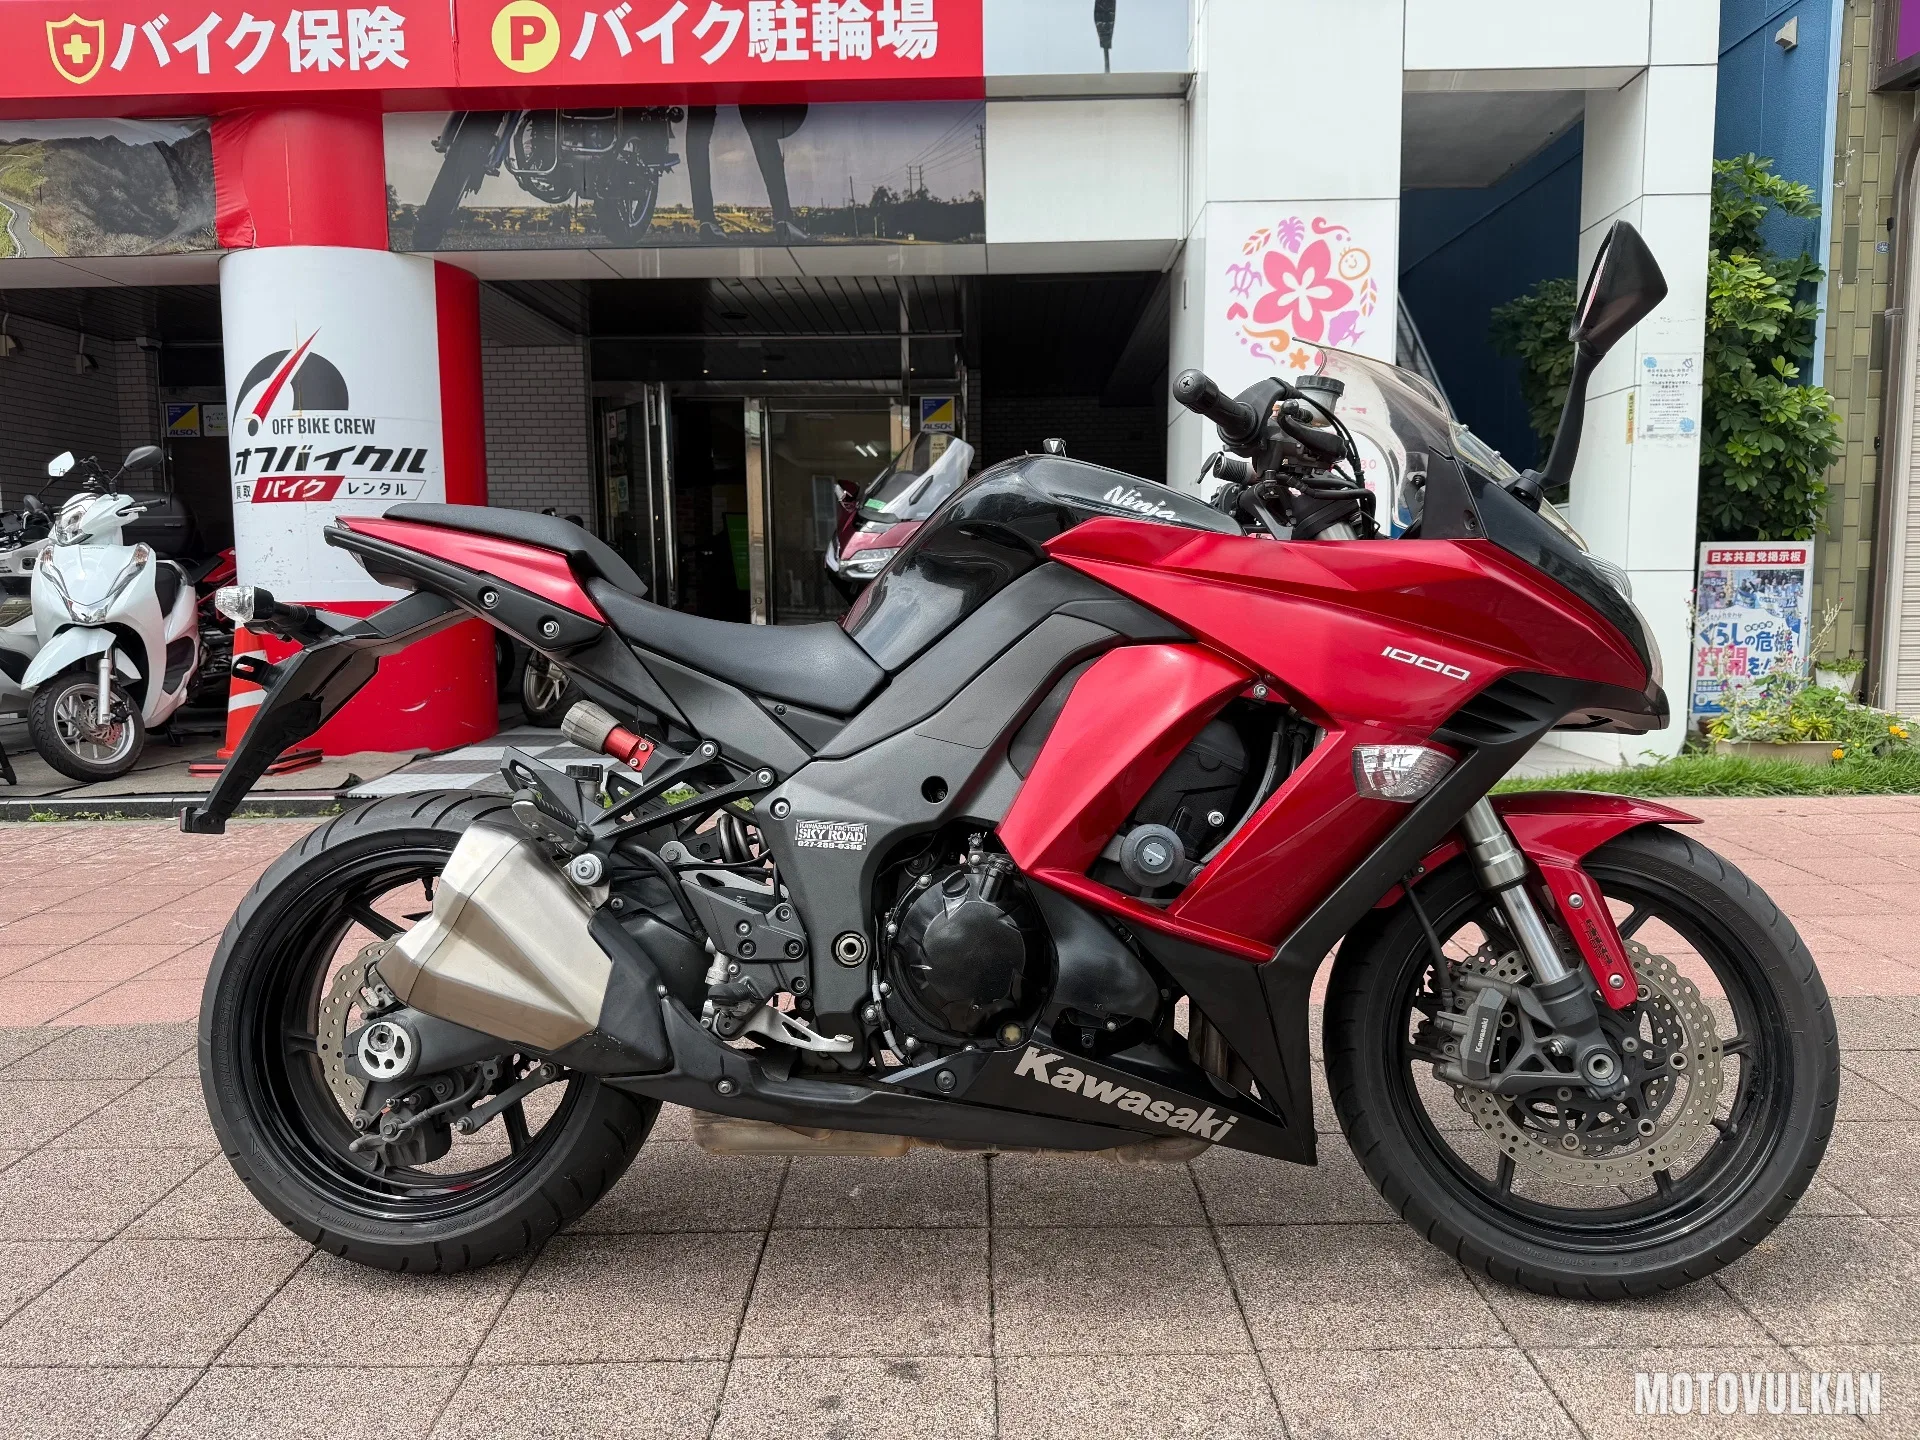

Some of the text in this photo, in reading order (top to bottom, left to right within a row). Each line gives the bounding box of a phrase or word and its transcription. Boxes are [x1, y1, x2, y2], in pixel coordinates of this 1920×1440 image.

[110, 5, 410, 74] バイク保険
[510, 0, 938, 65] P バイク駐輪場
[272, 418, 376, 435] OFF BIKE CREW
[234, 445, 429, 476] オフバイクル
[262, 479, 326, 498] バイク
[348, 482, 407, 495] レンタル
[1103, 485, 1182, 522] Ninja
[1711, 551, 1802, 563] 日本共産党掲示板
[1381, 646, 1471, 681] 1000
[798, 828, 864, 841] SKY ROAD
[799, 822, 865, 832] KAWASAKI FACTORY
[1475, 1017, 1489, 1053] Kawasaki
[1014, 1046, 1239, 1142] Kawasaki
